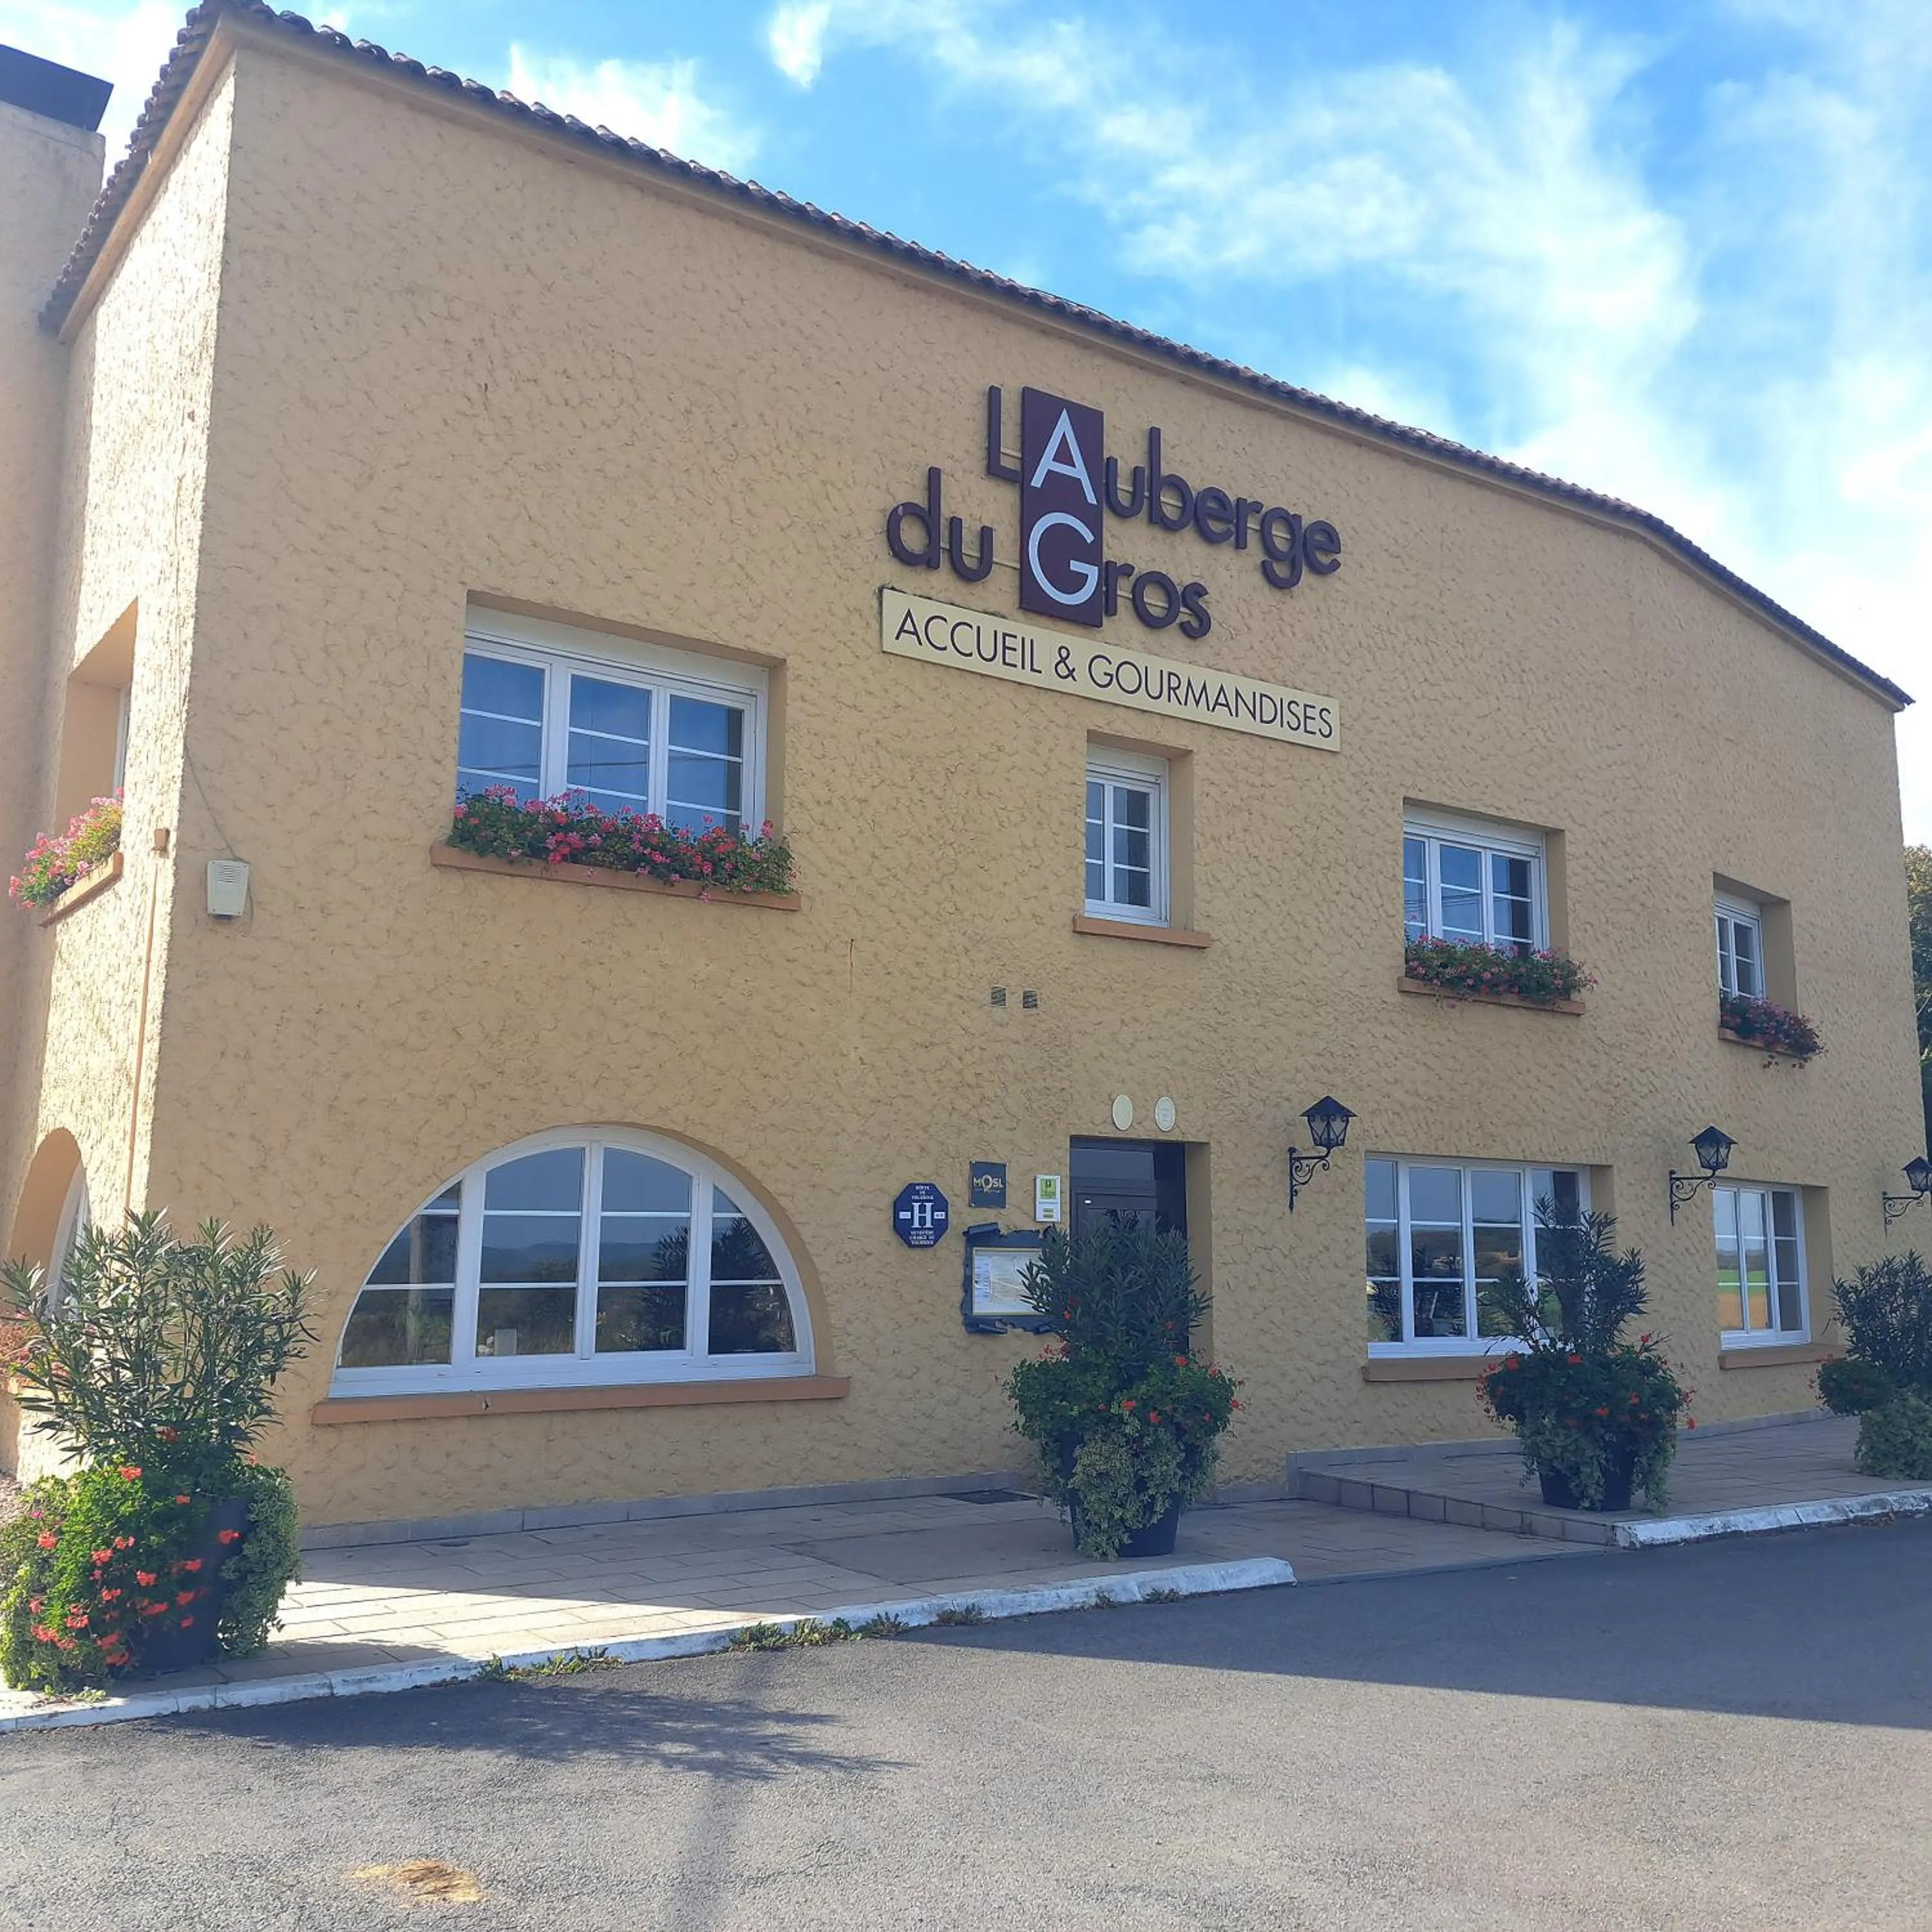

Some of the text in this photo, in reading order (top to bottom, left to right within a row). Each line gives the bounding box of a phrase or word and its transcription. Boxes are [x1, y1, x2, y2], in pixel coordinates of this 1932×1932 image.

[887, 466, 1212, 639] du Gros
[895, 608, 1334, 739] ACCUEIL & GOURMANDISES
[911, 1202, 934, 1228] H
